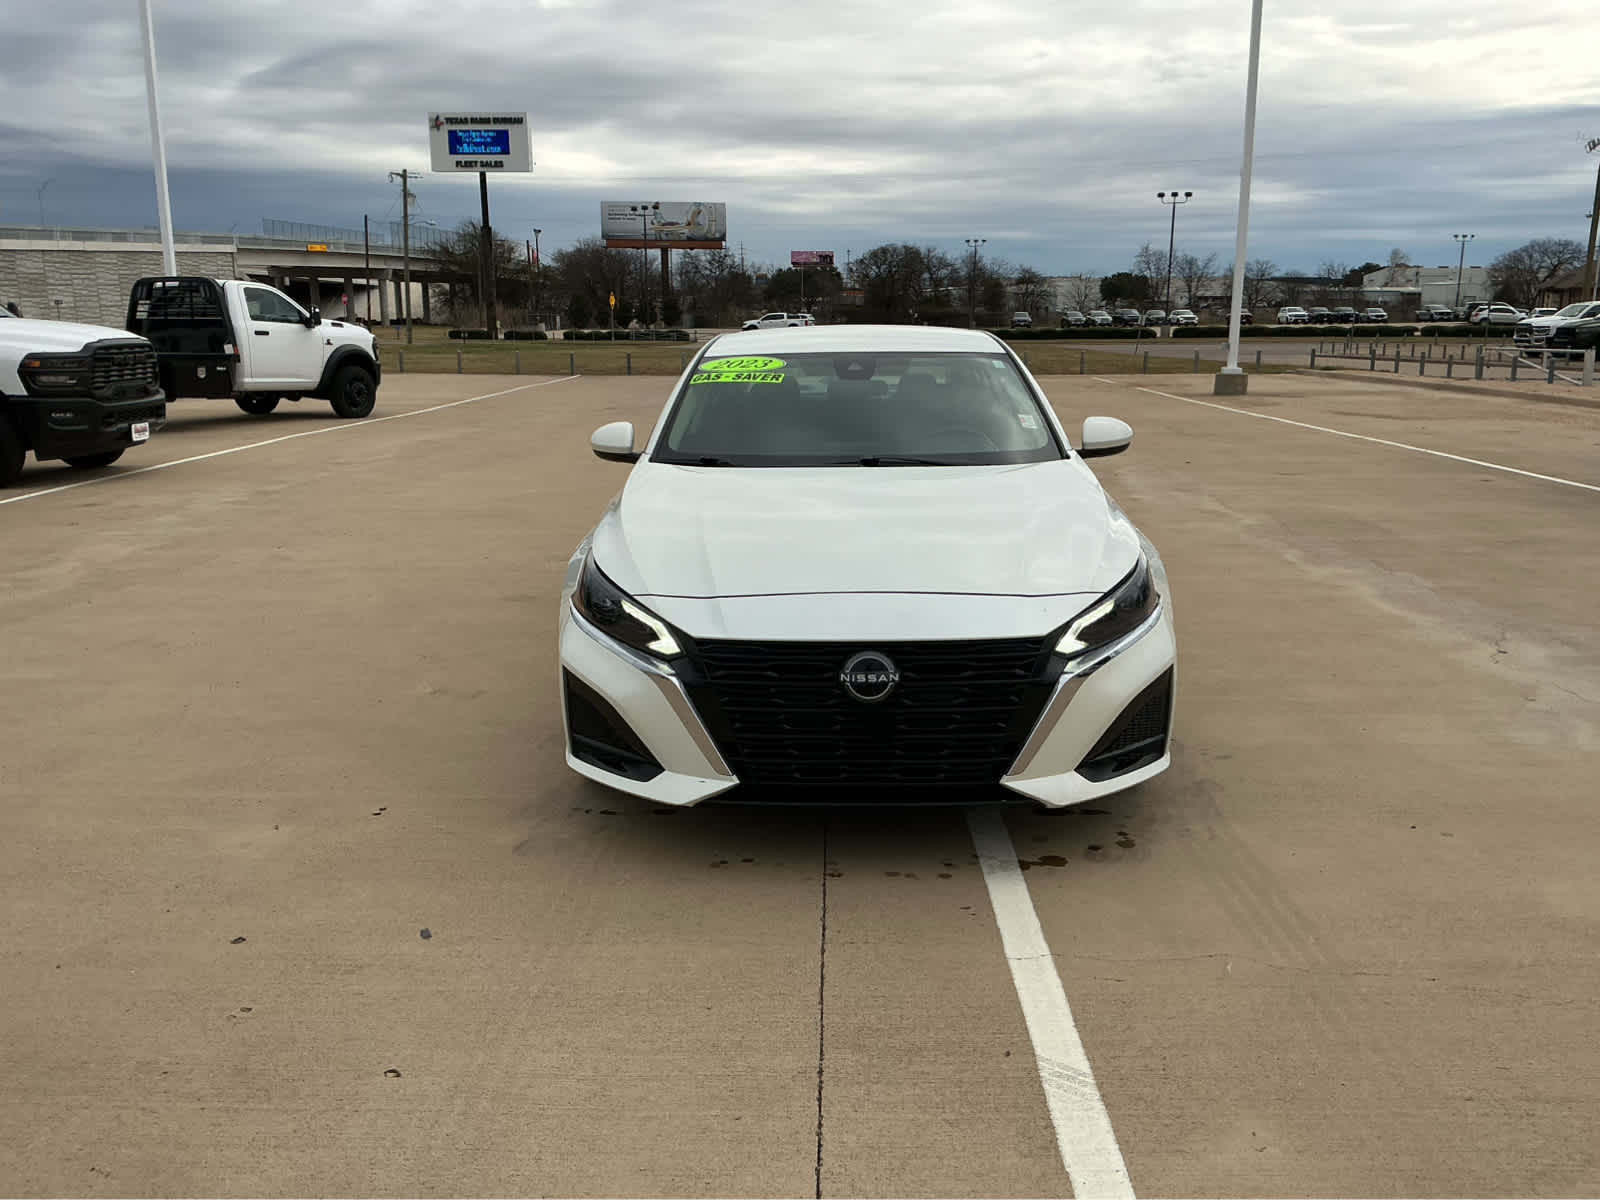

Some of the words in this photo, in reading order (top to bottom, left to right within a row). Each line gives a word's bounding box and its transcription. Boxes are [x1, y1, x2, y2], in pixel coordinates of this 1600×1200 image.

[444, 117, 468, 125] TEXAS
[455, 160, 478, 168] FLEET
[479, 160, 504, 168] SALES
[712, 359, 773, 370] 2023
[693, 373, 721, 382] GAS
[732, 373, 782, 382] SAVER
[840, 673, 899, 683] NISSAN
